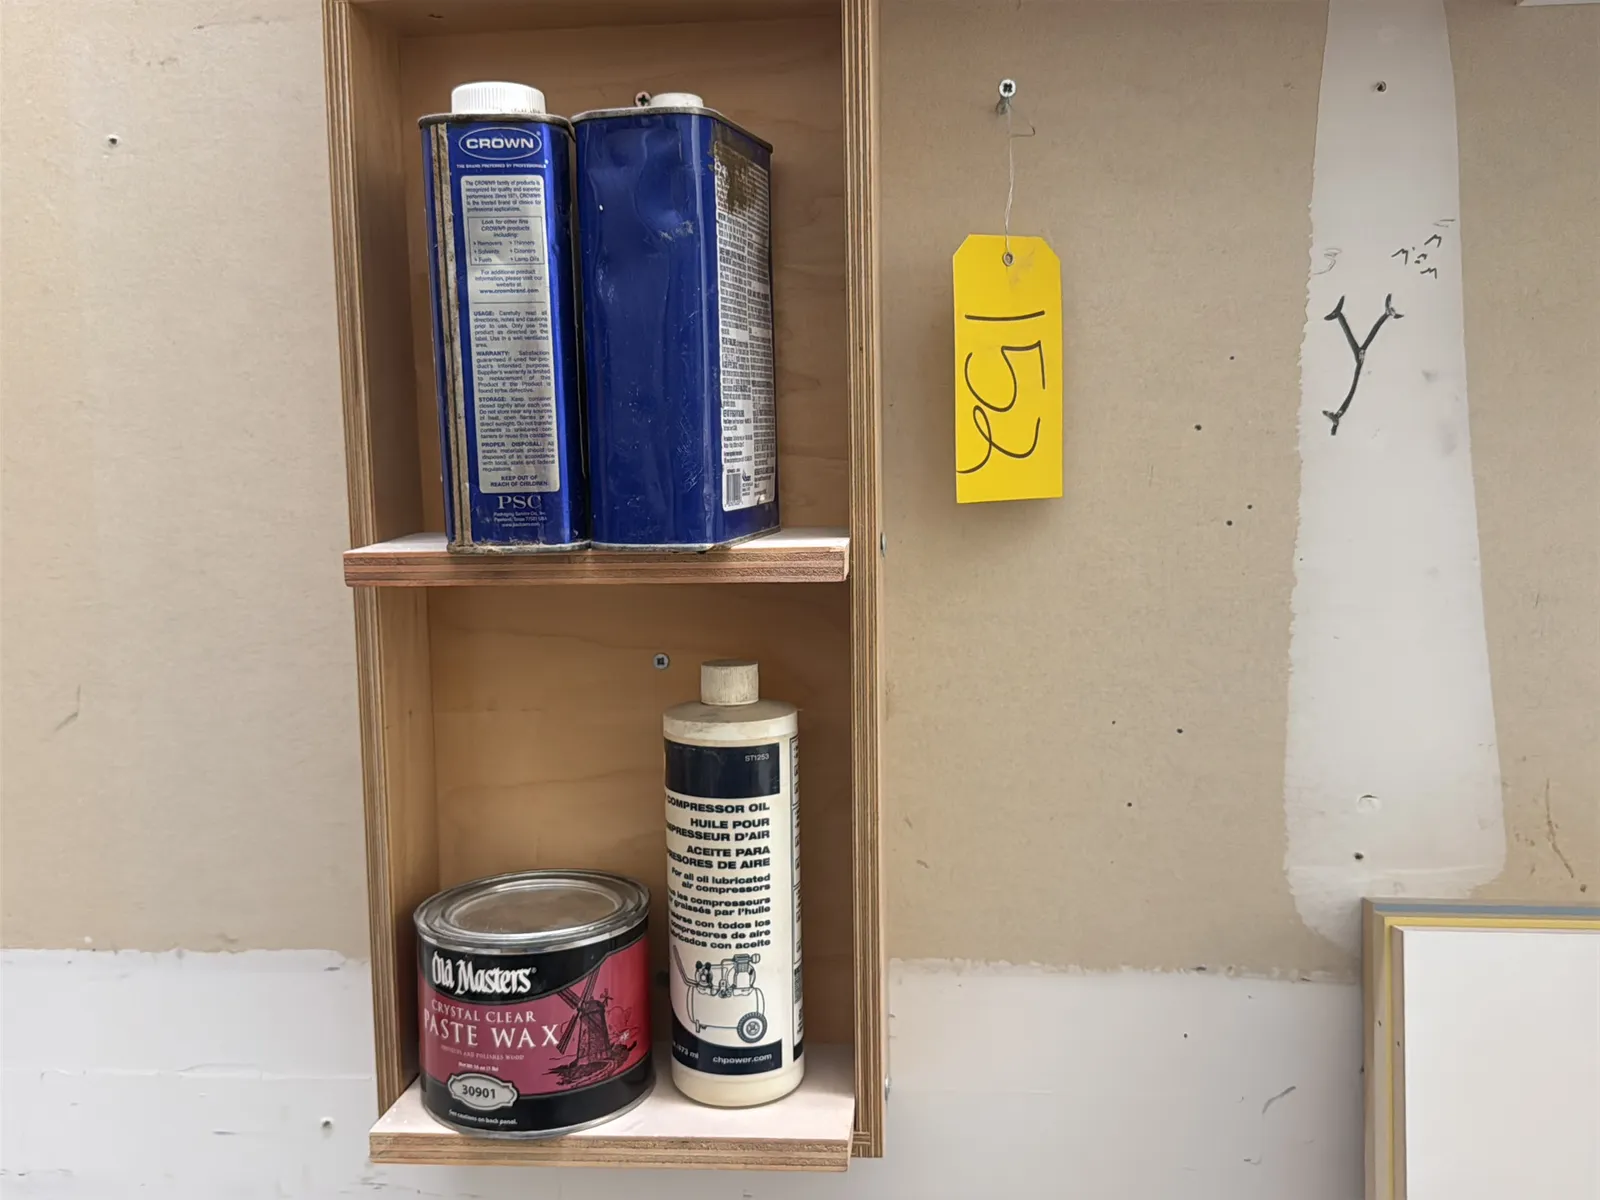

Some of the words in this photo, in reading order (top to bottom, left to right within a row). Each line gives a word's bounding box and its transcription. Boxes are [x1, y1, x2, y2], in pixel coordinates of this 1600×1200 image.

[466, 138, 534, 148] CROWN
[498, 495, 542, 510] PSC
[744, 752, 770, 762] ST1253
[748, 802, 770, 812] OIL
[690, 818, 728, 829] HUILE
[732, 818, 770, 829] POUR
[734, 830, 770, 841] D'AIR
[686, 845, 732, 857] ACEITE
[736, 846, 770, 857] PARA
[718, 861, 736, 870] DE
[740, 858, 770, 869] AIRE
[684, 872, 694, 881] all
[696, 876, 708, 884] oil
[712, 874, 770, 884] lubricated
[682, 881, 694, 890] air
[696, 883, 770, 894] compressors
[714, 908, 735, 916] par
[738, 906, 770, 916] l'huile
[695, 920, 714, 928] con
[718, 921, 752, 930] todos
[754, 919, 770, 928] los
[731, 930, 746, 939] de
[750, 928, 770, 938] aire
[735, 940, 770, 948] aceite
[432, 950, 456, 989] Old
[432, 1000, 480, 1022] CRYSTAL
[486, 1010, 536, 1022] CLEAR
[424, 1008, 478, 1046] PASTE
[491, 1024, 560, 1048] WAX
[712, 1053, 772, 1064] chpower.com
[462, 1084, 496, 1100] 30901
